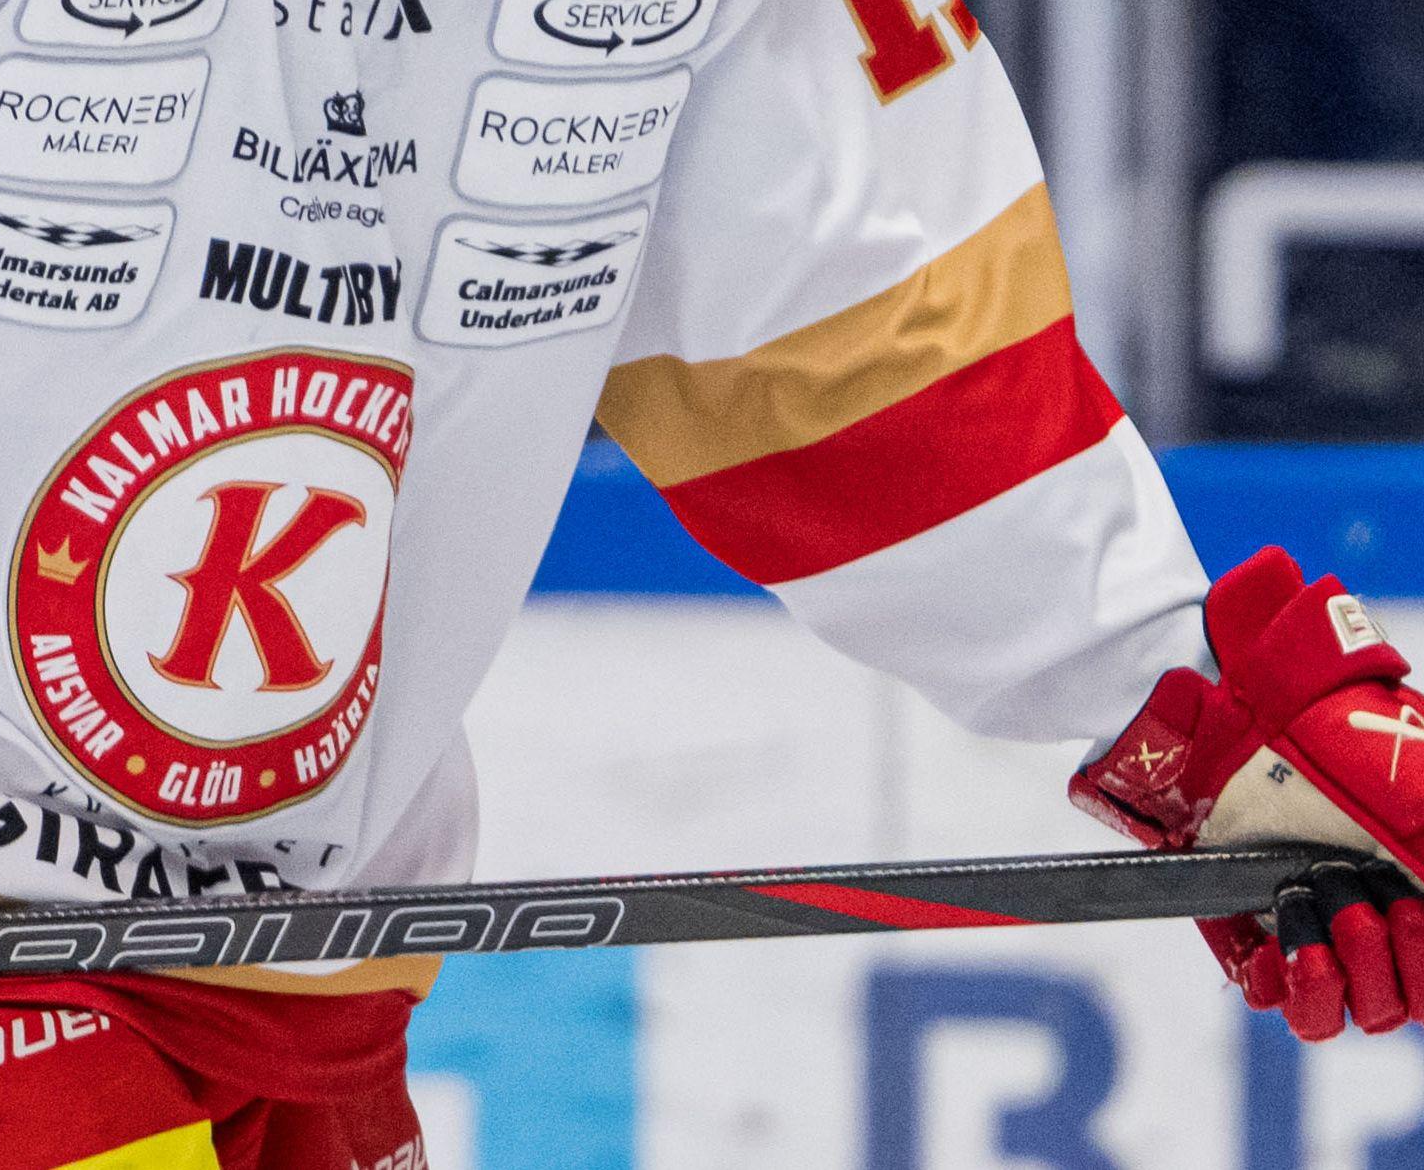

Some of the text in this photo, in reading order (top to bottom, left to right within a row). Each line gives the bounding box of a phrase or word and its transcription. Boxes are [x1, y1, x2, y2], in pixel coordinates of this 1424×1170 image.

[565, 0, 678, 30] SERVICE
[480, 100, 680, 144] ROCKNEBY
[42, 128, 139, 154] MÅLERI
[532, 150, 624, 176] MÅLERI
[85, 291, 120, 313] AB
[458, 266, 619, 303] Calmarsunds
[460, 294, 600, 330] Undertak AB
[60, 376, 252, 524] KALMAR
[146, 479, 367, 694] K
[29, 632, 125, 761] ANSVAR
[158, 760, 243, 807] GLÖD
